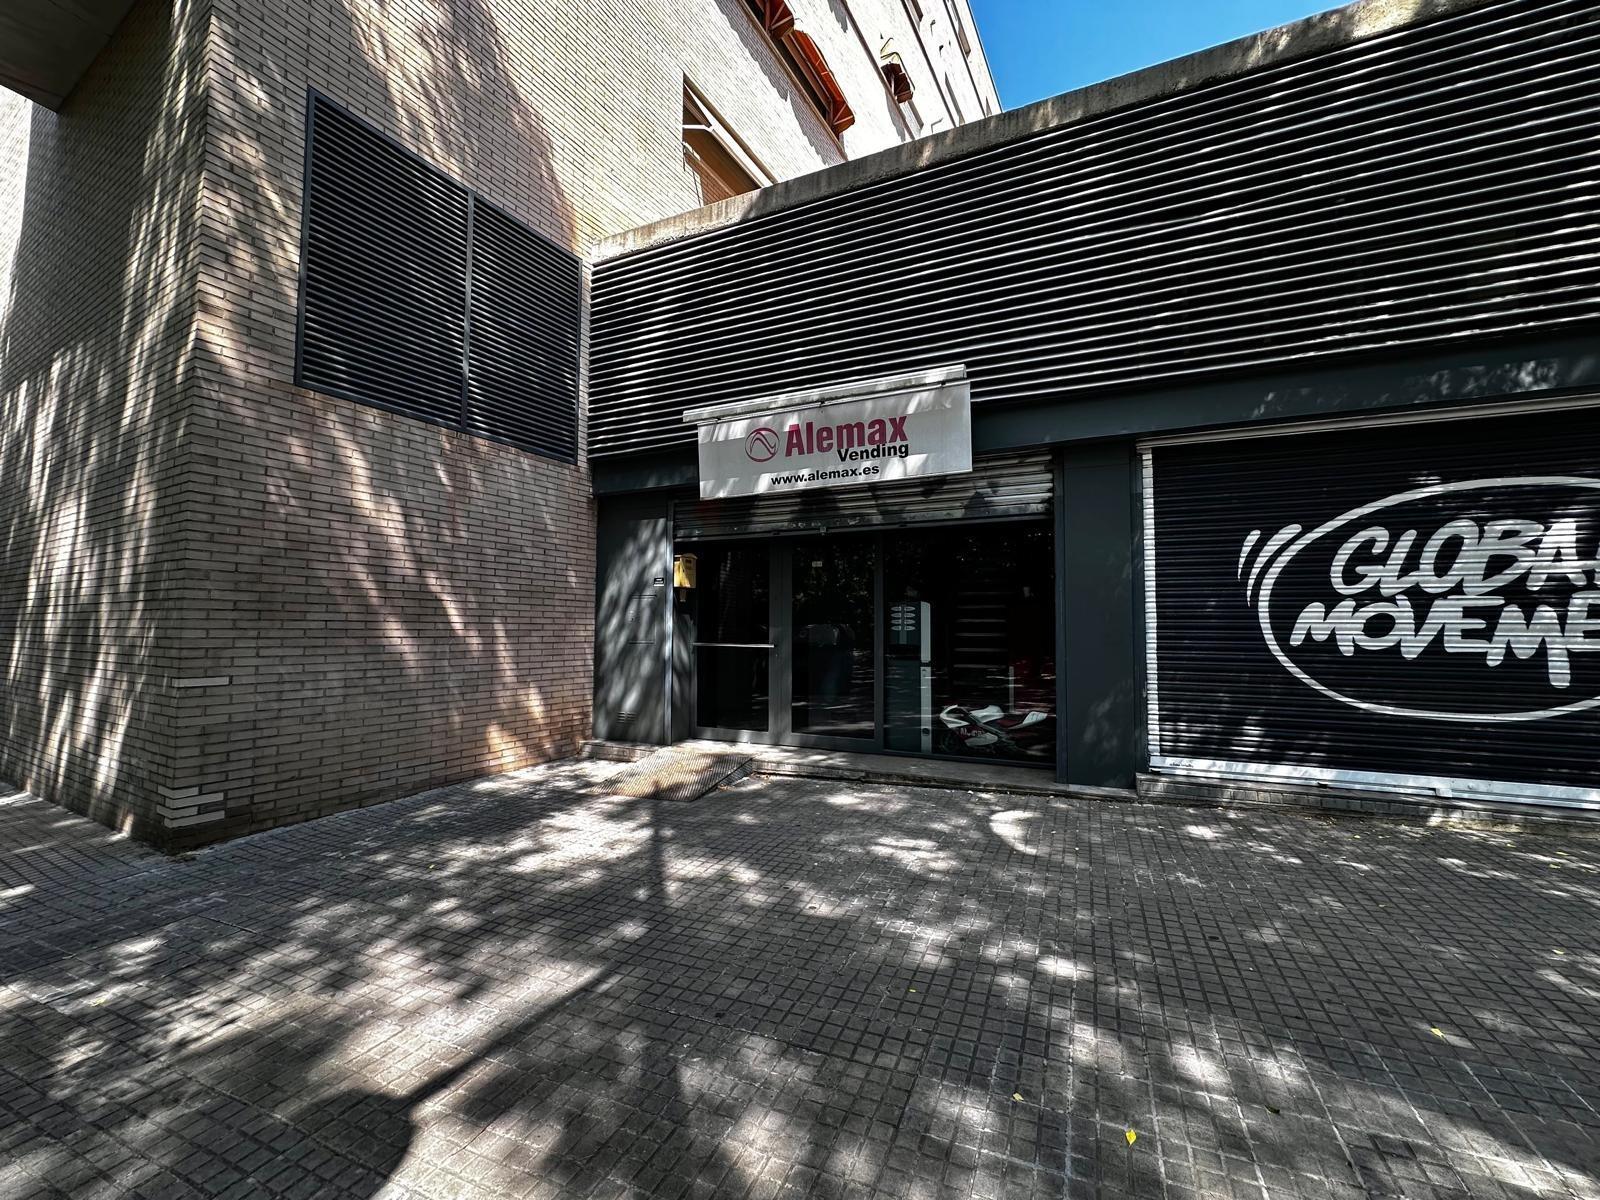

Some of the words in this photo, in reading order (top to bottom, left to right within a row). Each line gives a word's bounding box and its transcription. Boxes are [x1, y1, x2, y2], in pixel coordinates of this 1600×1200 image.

[785, 416, 908, 457] Alemax
[837, 443, 909, 462] Vending
[771, 464, 880, 485] www.alemax.es
[1330, 519, 1600, 597] GLOBA
